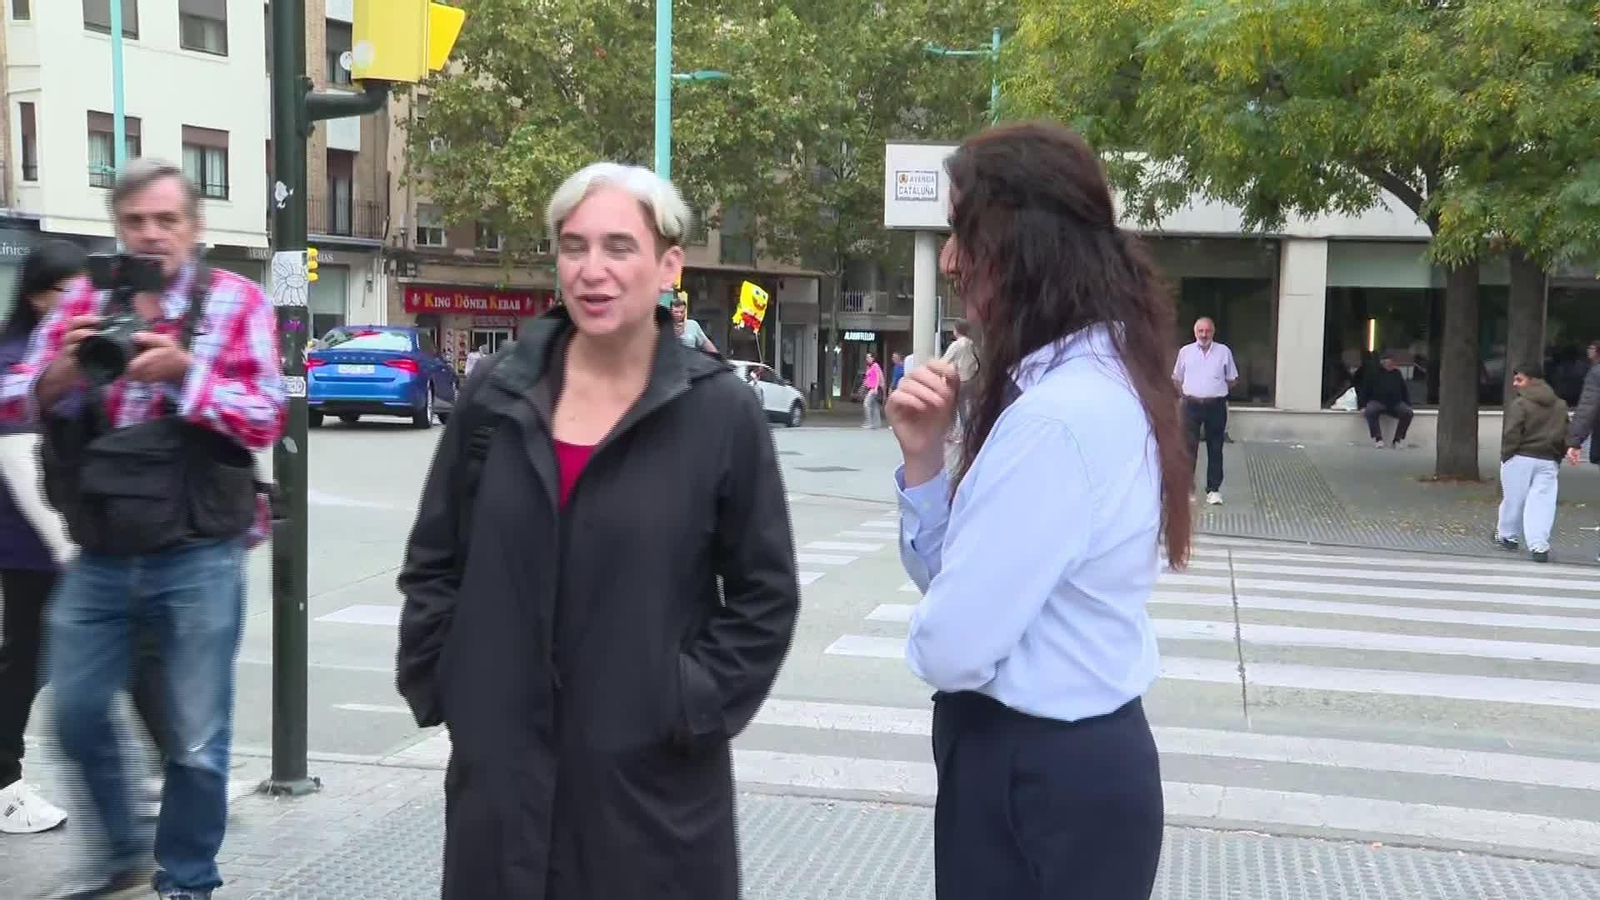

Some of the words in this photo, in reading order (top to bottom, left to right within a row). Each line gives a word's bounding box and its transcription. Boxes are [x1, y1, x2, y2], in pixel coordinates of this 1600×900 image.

[424, 293, 451, 308] KING
[454, 293, 488, 309] DÖNER
[489, 294, 521, 310] KEBAB
